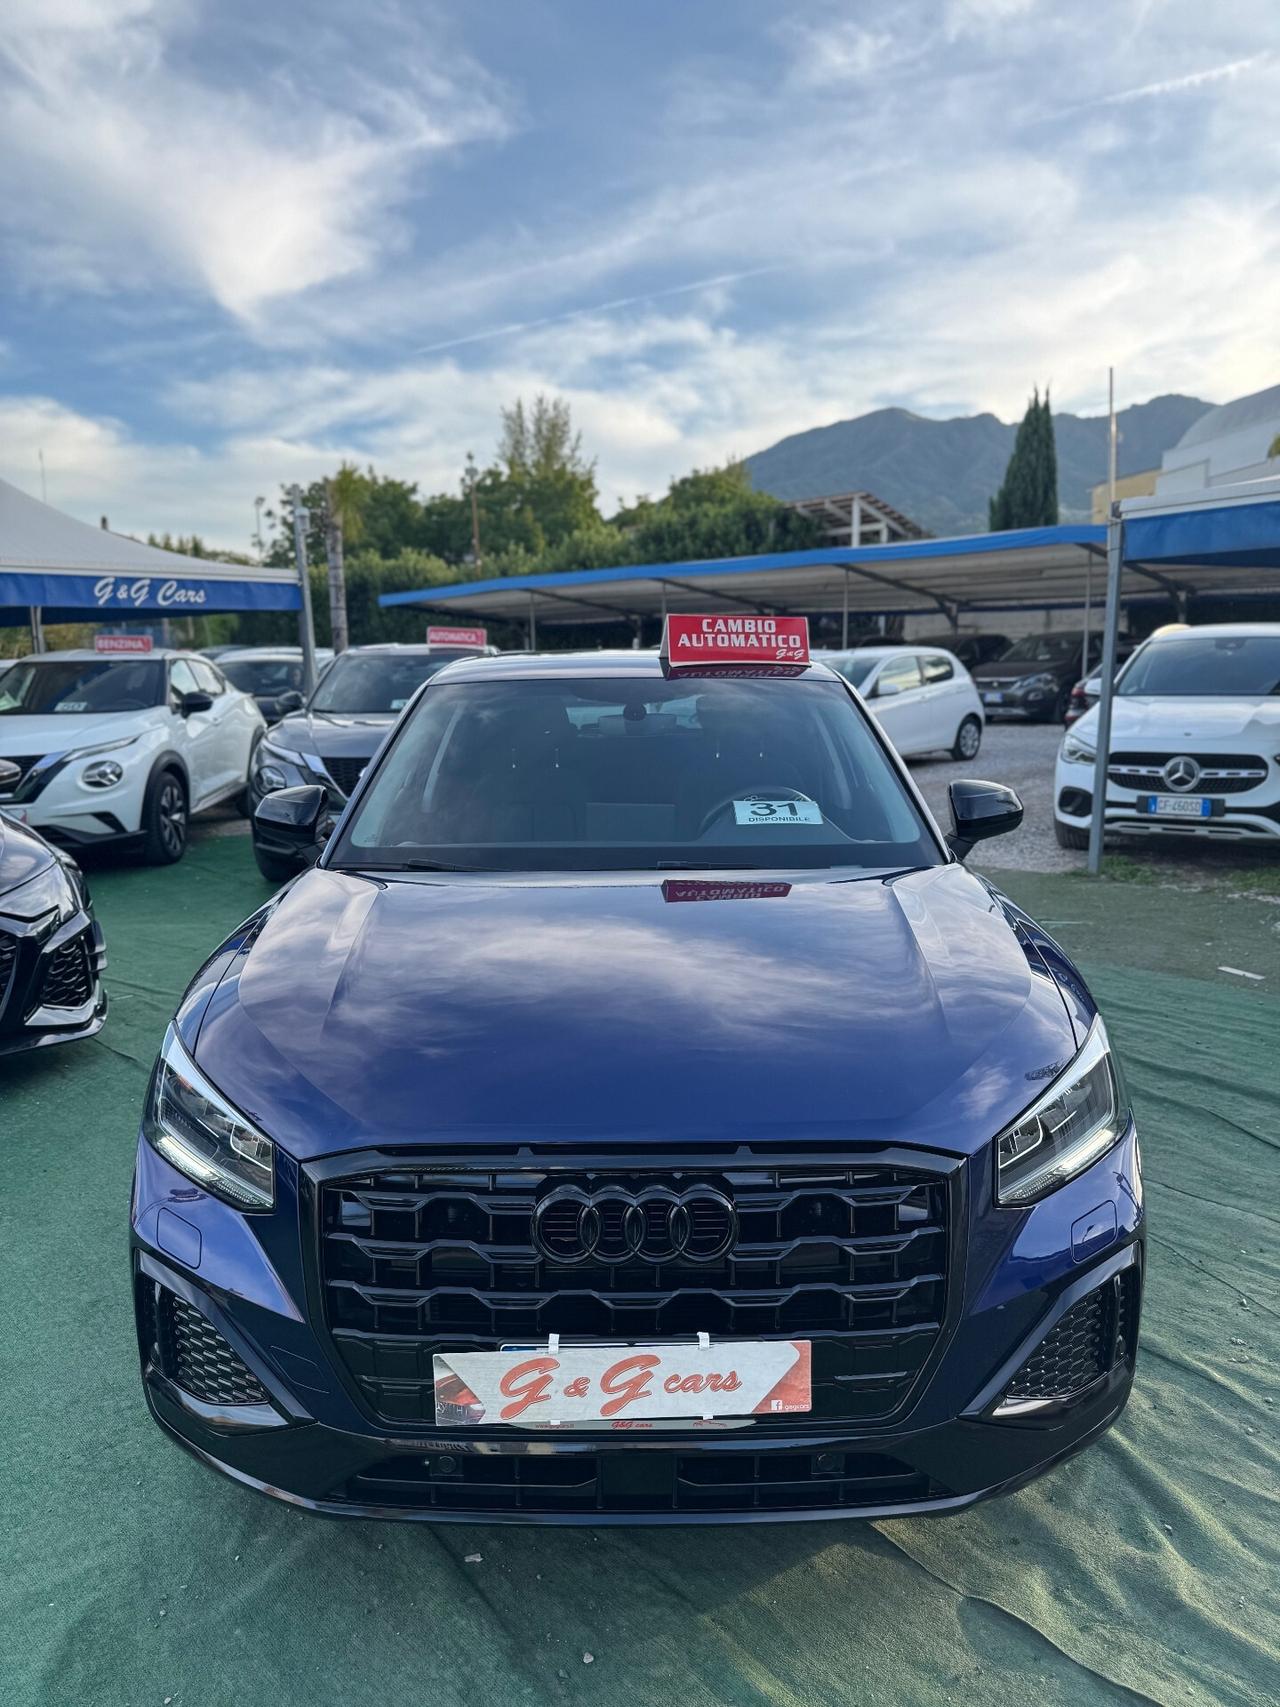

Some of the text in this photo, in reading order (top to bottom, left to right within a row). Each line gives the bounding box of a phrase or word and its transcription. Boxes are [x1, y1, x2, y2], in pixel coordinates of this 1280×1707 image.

[157, 580, 206, 606] Cars
[702, 619, 776, 633] CAMBIO
[97, 639, 145, 649] BENZINA
[678, 633, 801, 647] AUTOMATICO
[750, 802, 798, 816] 31
[663, 1369, 743, 1394] cars
